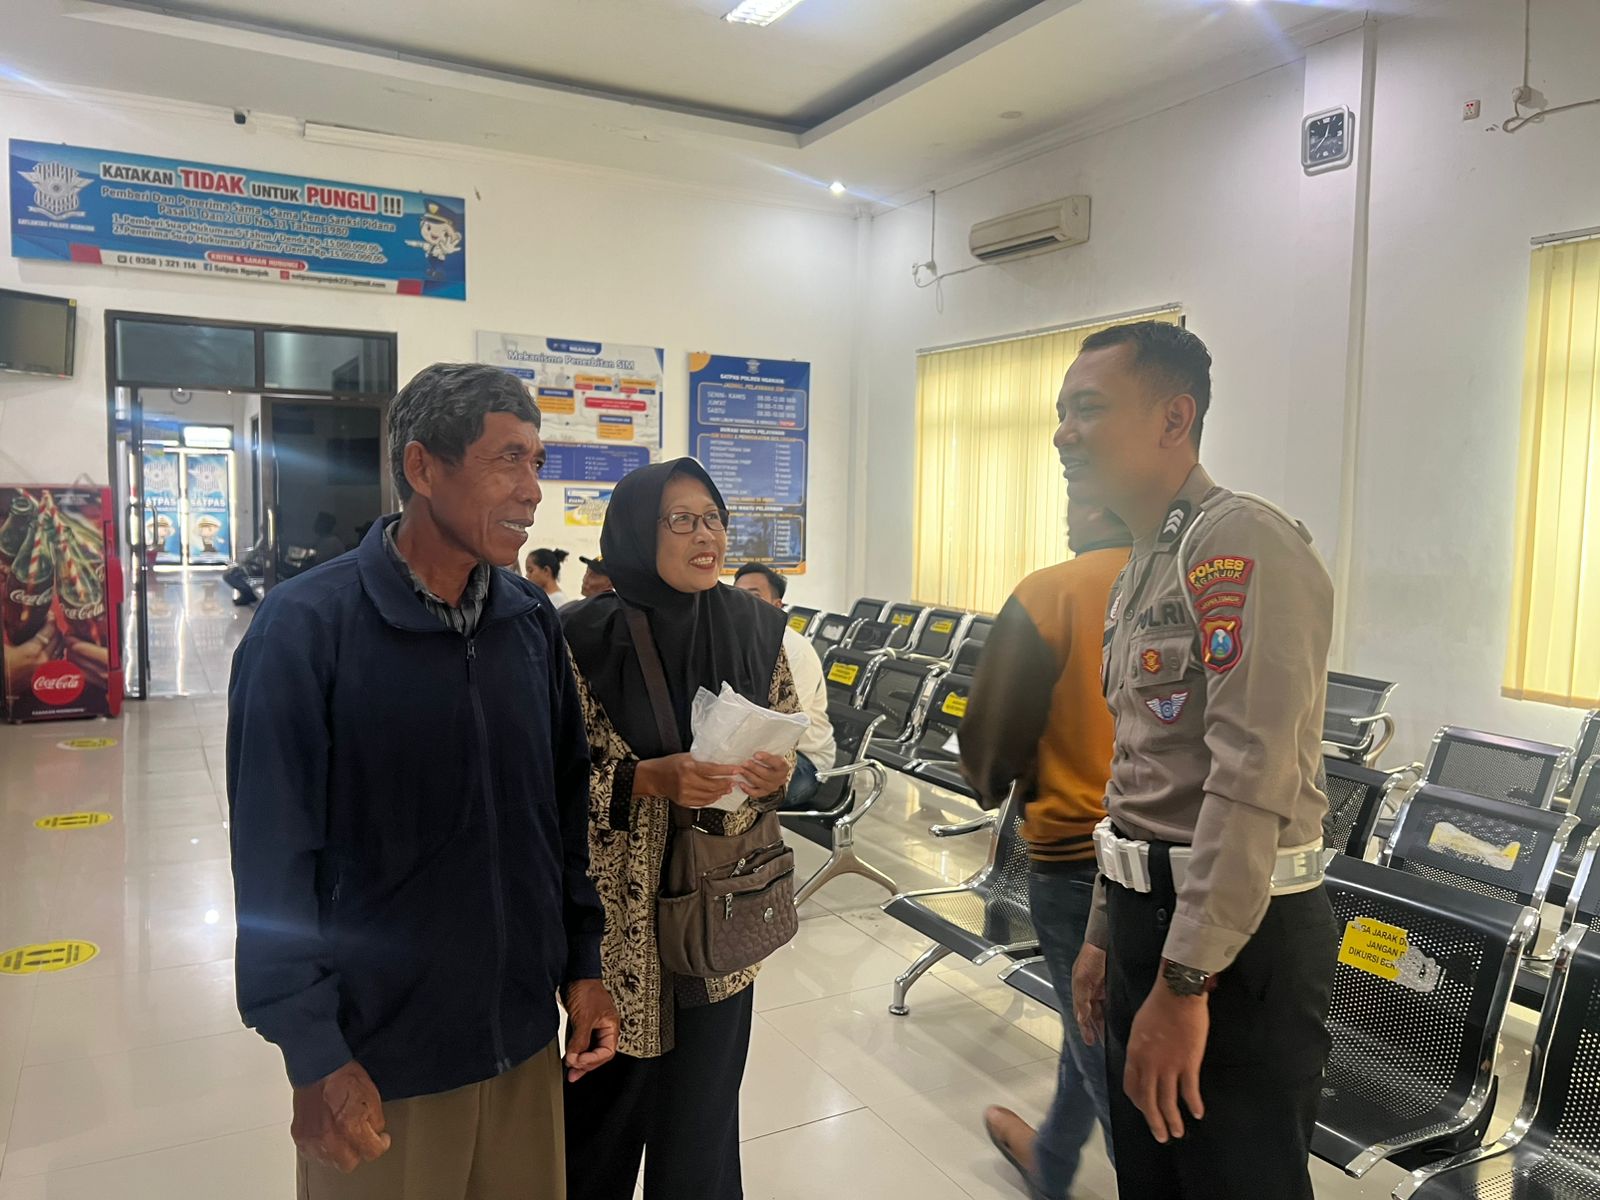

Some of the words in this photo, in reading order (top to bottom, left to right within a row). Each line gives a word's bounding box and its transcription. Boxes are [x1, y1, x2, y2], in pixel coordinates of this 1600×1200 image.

[101, 163, 174, 186] KATAKAN
[179, 168, 246, 197] TIDAK
[251, 183, 300, 202] UNTUK
[306, 186, 378, 213] PUNGLI
[383, 196, 402, 215] !!!
[102, 187, 150, 201] Pemberi
[152, 192, 176, 205] Dan
[177, 195, 230, 212] Penerima
[231, 203, 263, 216] Sama
[271, 207, 300, 220] Sama
[302, 211, 328, 224] Kena
[329, 214, 361, 229] Sanksi
[362, 218, 397, 233] Pidana
[158, 204, 188, 217] Pasal
[201, 209, 224, 222] Dan
[235, 214, 254, 225] UU
[290, 220, 322, 234] Tahun
[124, 214, 164, 227] Pemberi
[166, 218, 189, 232] Suap
[190, 222, 235, 237] Hukuman
[244, 230, 273, 241] Tahun
[280, 234, 309, 245] Denda
[124, 225, 170, 239] Penerima
[171, 230, 195, 244] Suap
[196, 233, 241, 248] Hukuman
[250, 239, 280, 252] Tahun
[166, 259, 180, 269] 321
[507, 351, 564, 365] Mekanisme
[564, 356, 615, 369] Penerbitan
[616, 359, 635, 371] SIM
[145, 496, 178, 507] ATPAS
[1188, 559, 1245, 583] POLRES
[1372, 929, 1398, 943] JARAK
[1348, 946, 1379, 964] DIKURSI
[1366, 939, 1398, 957] JANGAN
